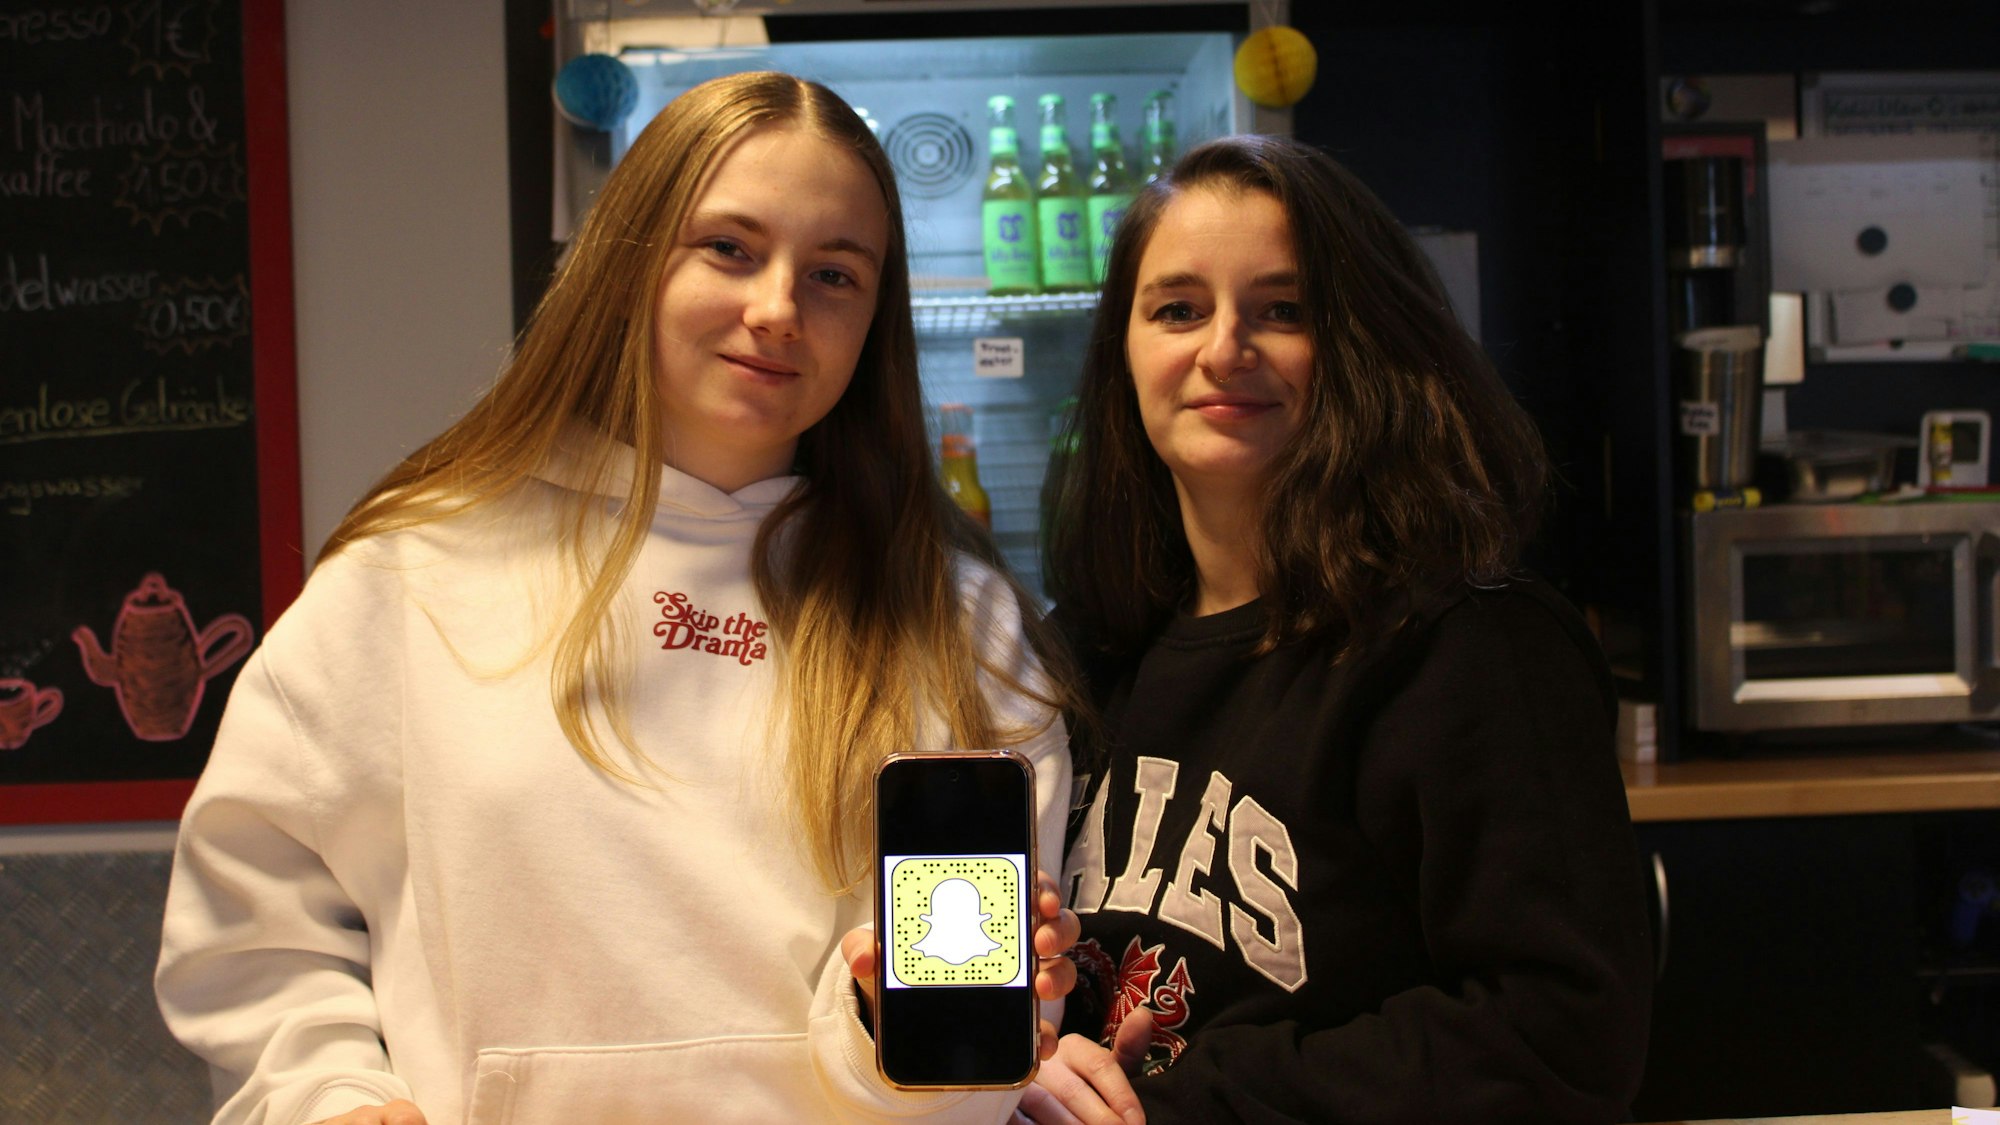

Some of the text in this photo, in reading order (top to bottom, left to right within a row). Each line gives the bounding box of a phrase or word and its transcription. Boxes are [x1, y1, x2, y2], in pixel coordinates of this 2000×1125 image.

[186, 84, 217, 144] &
[653, 591, 768, 642] Skip the
[653, 621, 767, 666] Drama
[1061, 755, 1308, 994] ALES
